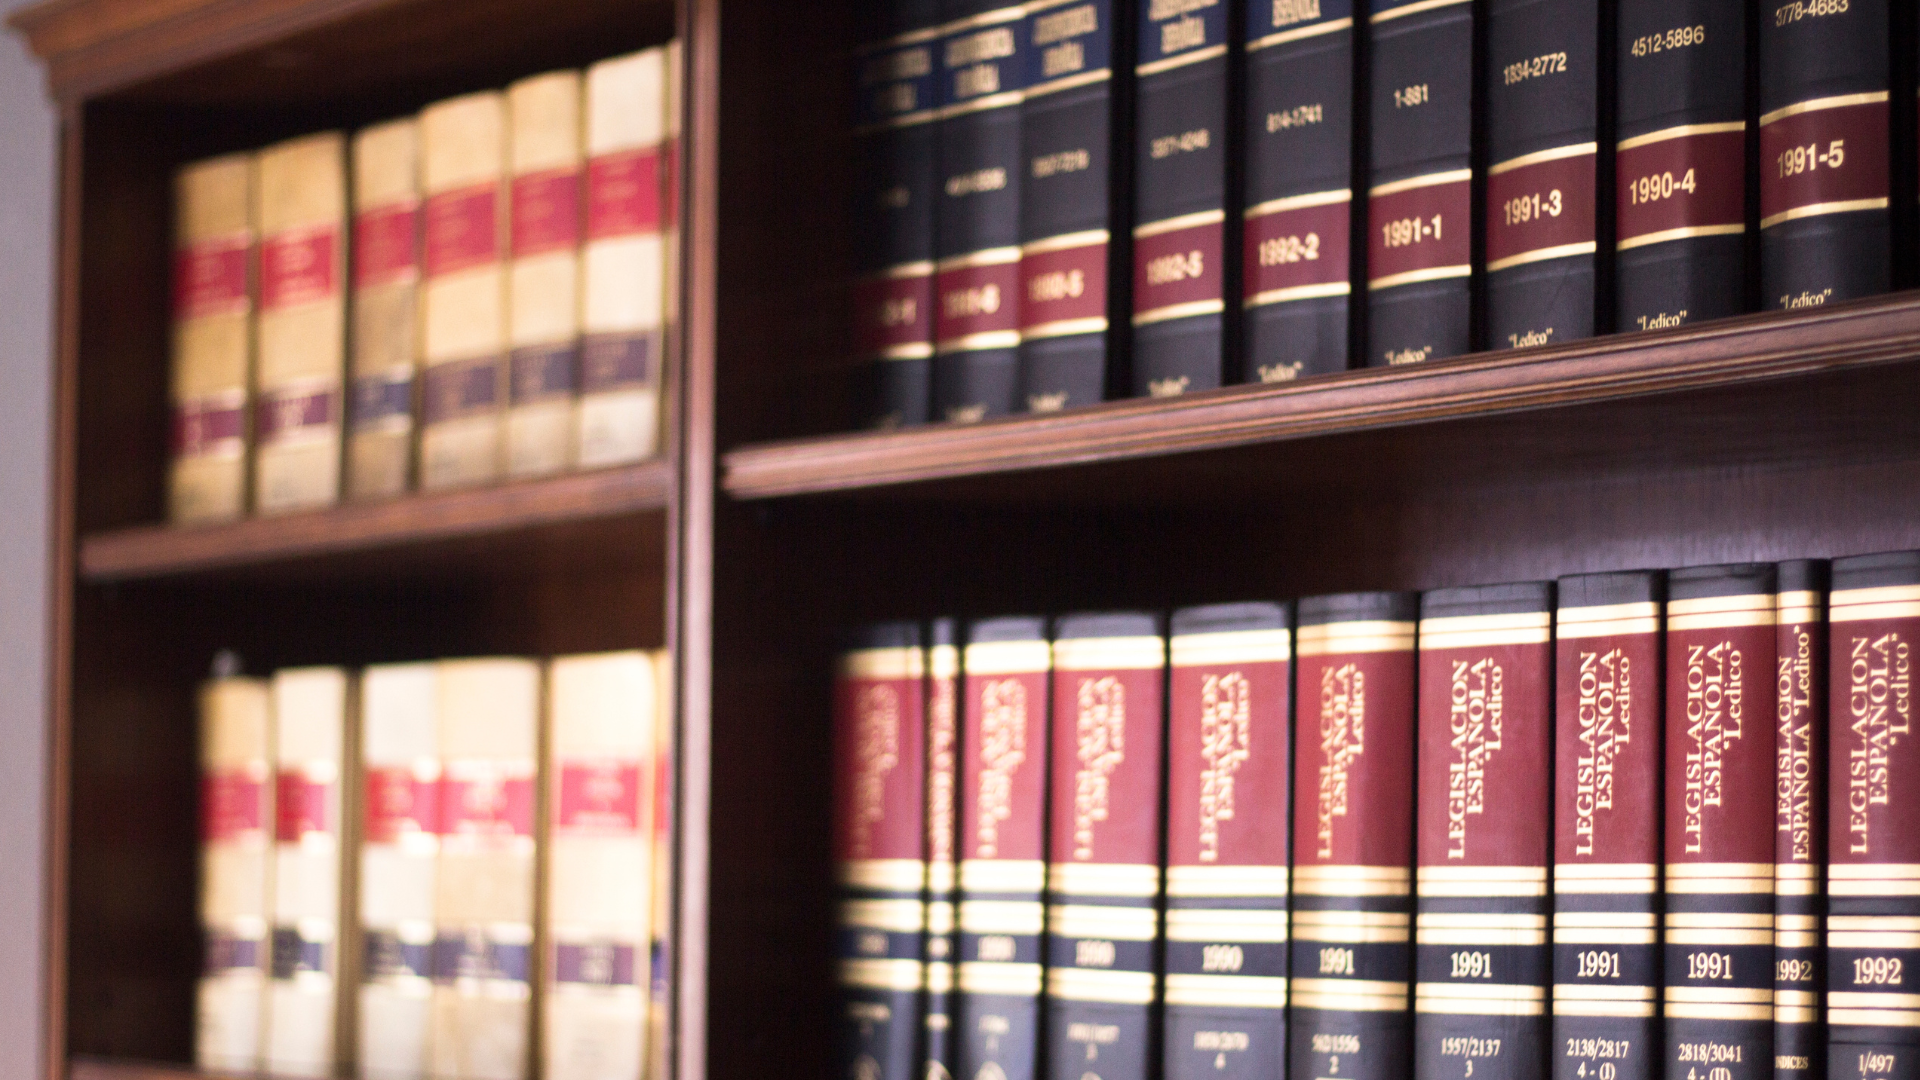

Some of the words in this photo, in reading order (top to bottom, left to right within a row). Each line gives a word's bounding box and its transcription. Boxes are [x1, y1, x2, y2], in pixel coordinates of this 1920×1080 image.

[1776, 0, 1849, 27] 3778-4683
[1631, 25, 1705, 57] 4512-5896
[1503, 52, 1567, 85] 1834-2772
[1777, 140, 1844, 178] 1991-5
[1629, 168, 1697, 204] 1990-4
[1504, 189, 1562, 226] 1991-3
[1382, 213, 1442, 249] 1991-1
[1259, 232, 1320, 267] 1992-2
[1466, 657, 1487, 814] ESPAÑOLA
[1595, 648, 1616, 810] ESPAÑOLA
[1702, 641, 1724, 808] ESPAÑOLA
[1867, 633, 1889, 805] ESPAÑOLA
[1448, 659, 1469, 859] LEGISLACION
[1576, 651, 1597, 856] LEGISLACION
[1685, 643, 1704, 854] LEGISLACION
[1778, 655, 1792, 833] LEGISLACION
[1850, 636, 1868, 854] LEGISLACION
[1317, 666, 1335, 858] LEGISLACION
[1791, 722, 1810, 861] ESPAÑOLA
[1319, 947, 1355, 975] 1991
[1450, 951, 1493, 978] 1991
[1577, 951, 1621, 978] 1991
[1687, 952, 1733, 980] 1991
[1775, 959, 1813, 981] 1992
[1853, 956, 1902, 985] 1992
[1441, 1036, 1501, 1058] 1557/2137
[1566, 1036, 1629, 1061] 2138/2817
[1678, 1040, 1742, 1066] 2818/3041
[1774, 1056, 1809, 1069] NDICES
[1859, 1050, 1895, 1077] 1/497
[1464, 1060, 1473, 1078] 3
[1577, 1061, 1586, 1078] 4
